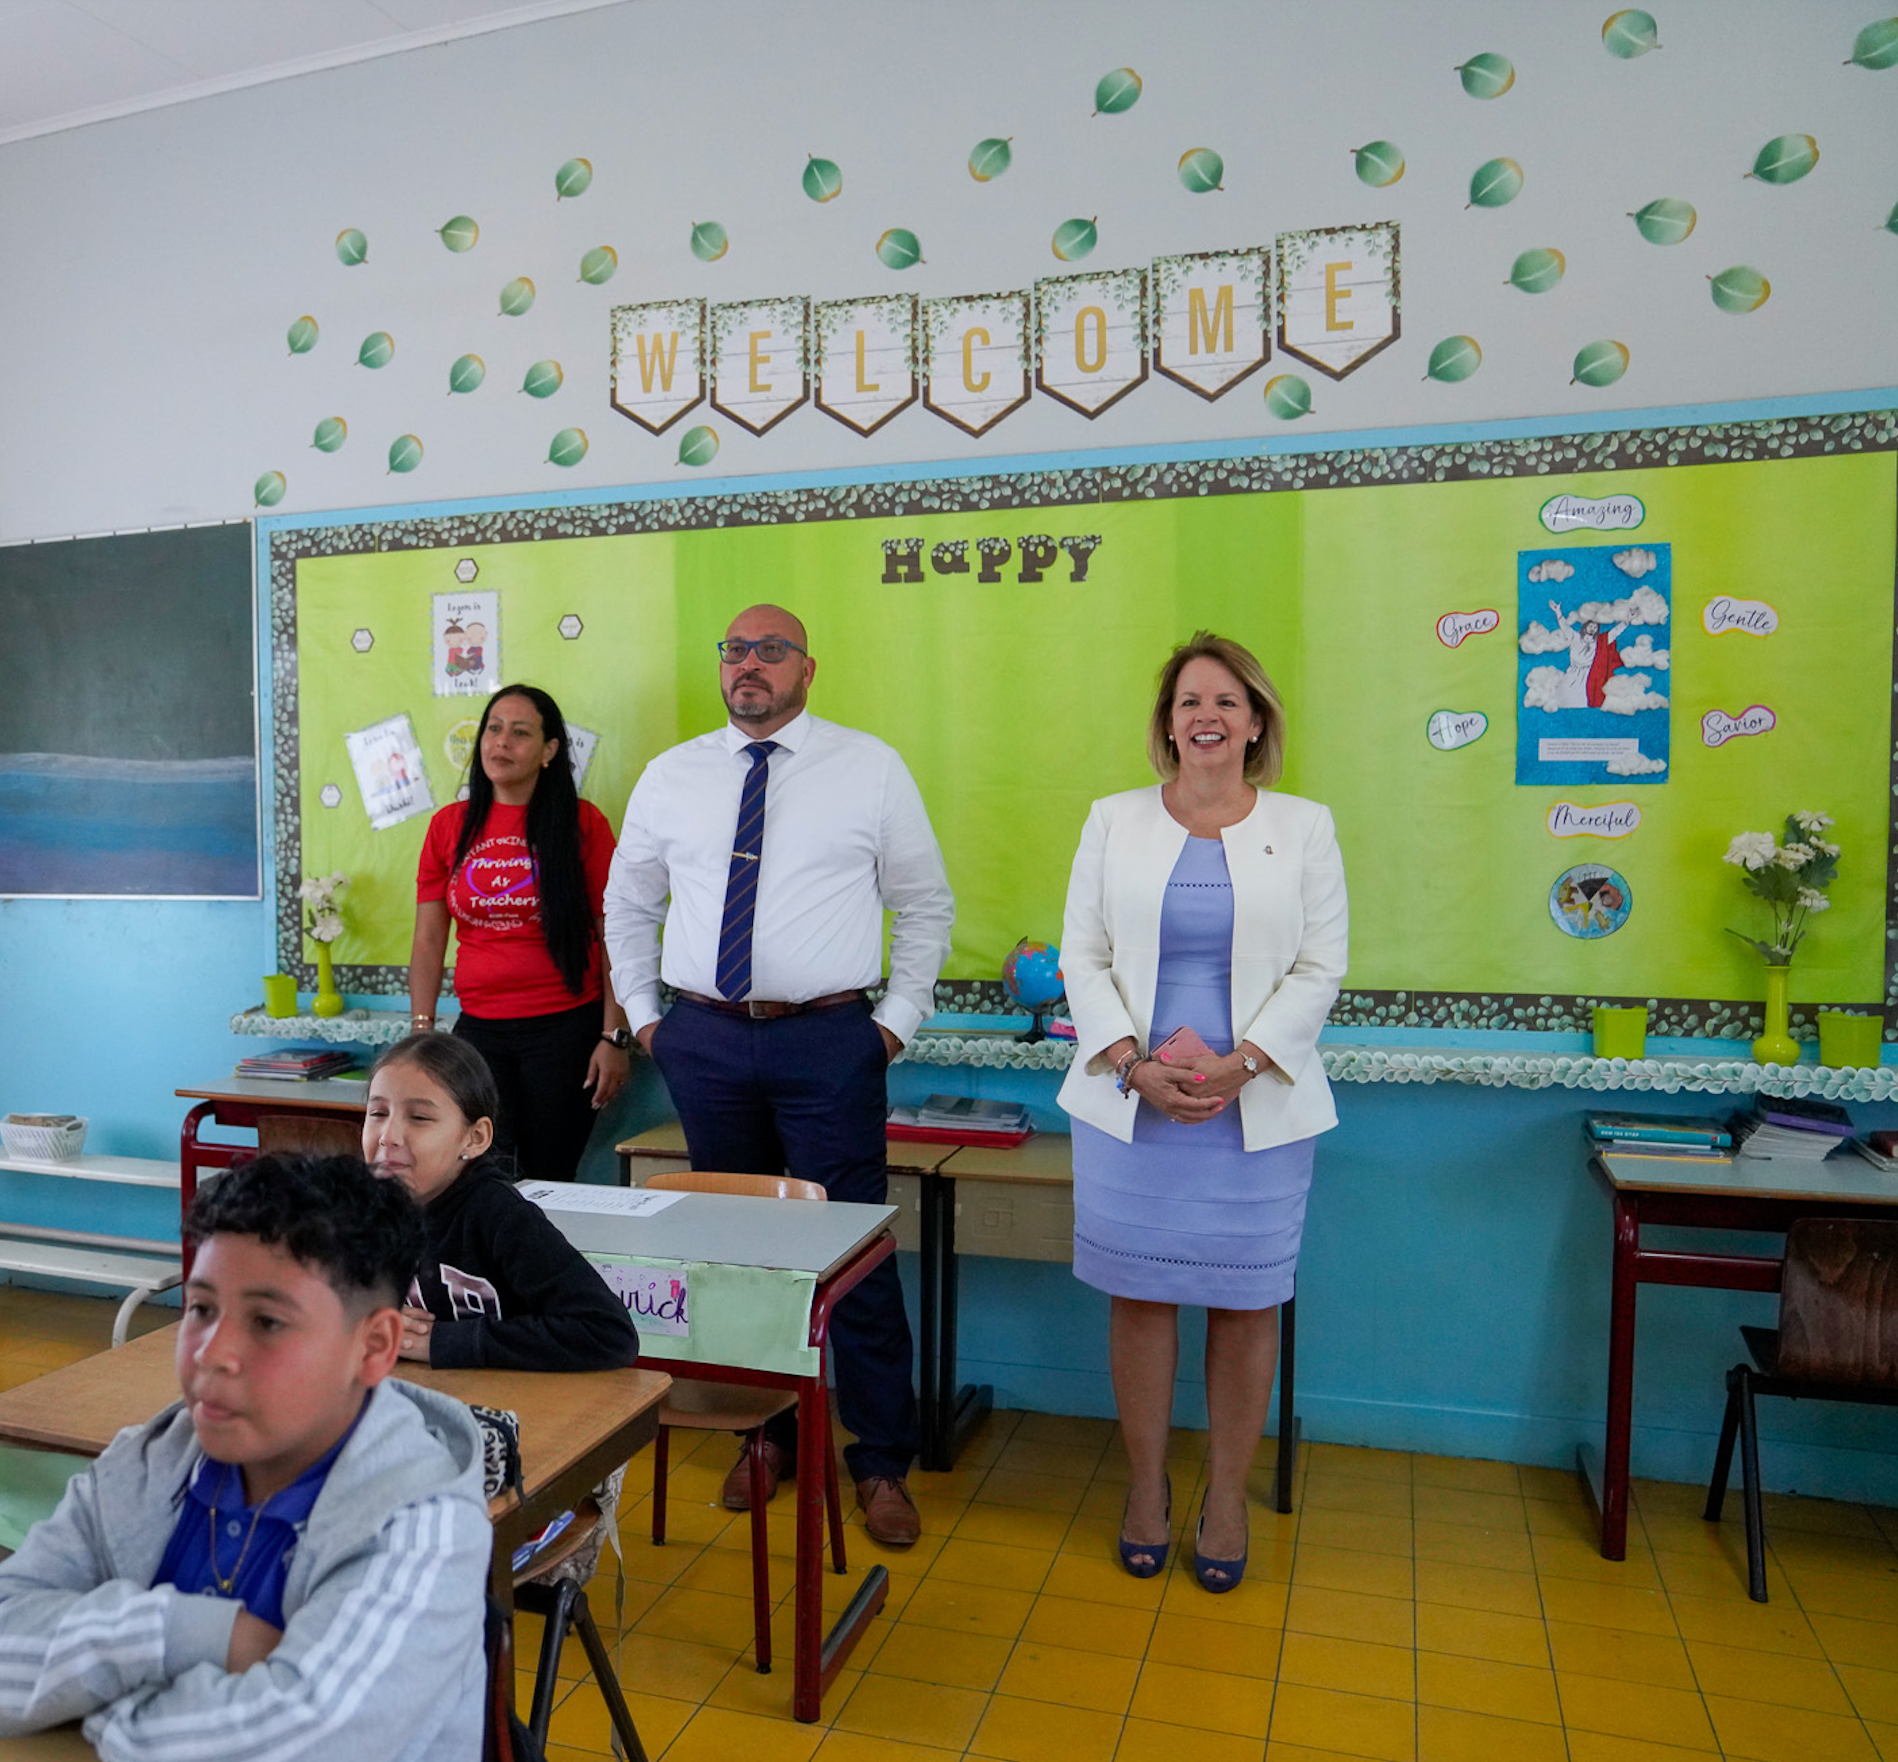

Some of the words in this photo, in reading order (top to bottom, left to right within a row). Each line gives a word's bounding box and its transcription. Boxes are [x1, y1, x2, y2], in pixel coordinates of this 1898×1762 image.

[636, 261, 1354, 393] WELCOME
[1549, 496, 1634, 525] Amazing
[1711, 599, 1773, 630] Gentle
[1442, 616, 1492, 645] Grace
[1432, 715, 1480, 743] Hope
[1706, 713, 1767, 743] Savior
[1554, 804, 1634, 831] Merciful
[471, 857, 532, 870] Thriving
[491, 875, 511, 887] As
[469, 894, 539, 908] Teachers
